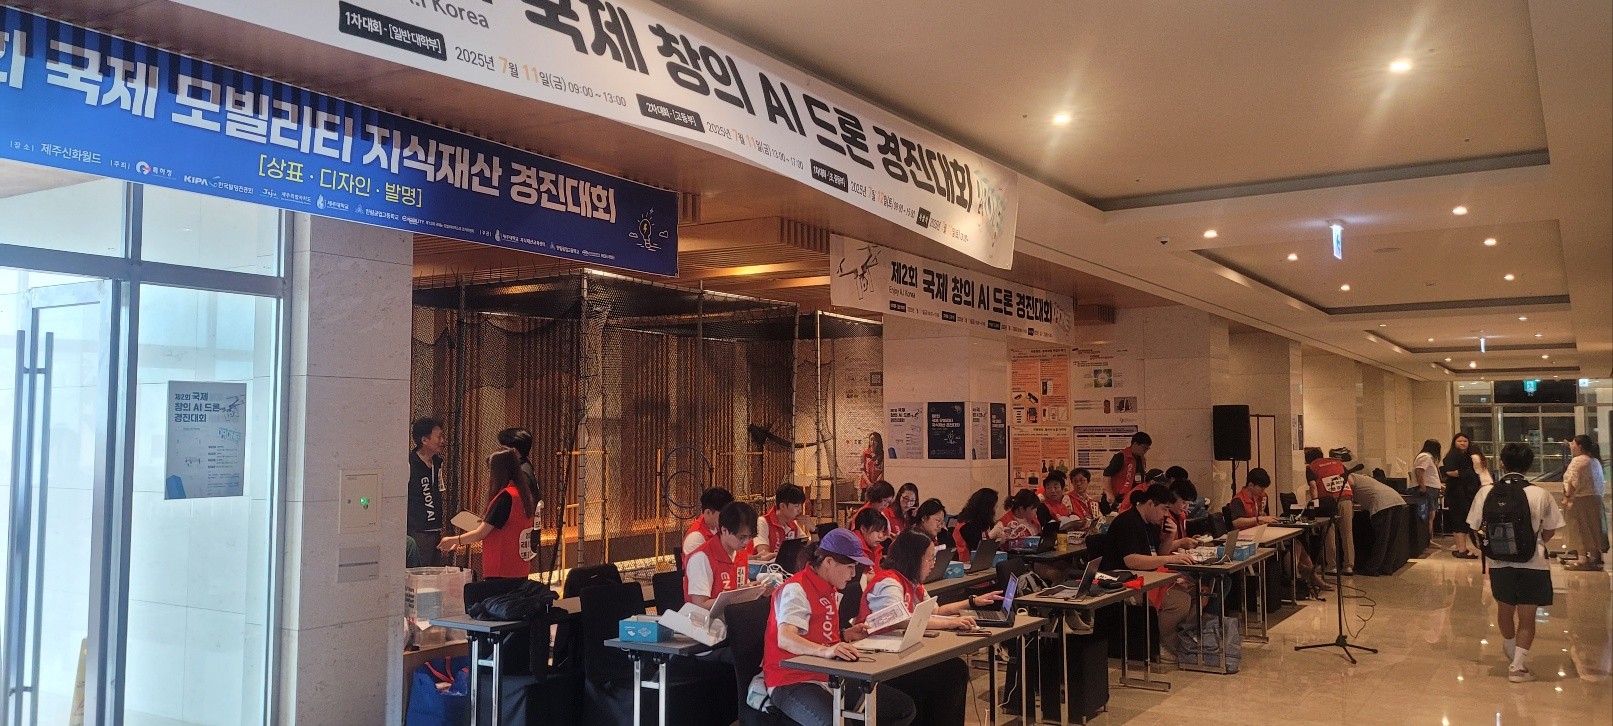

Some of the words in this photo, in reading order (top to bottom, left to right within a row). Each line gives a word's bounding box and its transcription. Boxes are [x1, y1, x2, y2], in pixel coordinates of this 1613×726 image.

[434, 0, 490, 28] Korea
[344, 12, 382, 36] 1차대회
[455, 46, 496, 72] 2025년
[499, 56, 520, 78] 7월
[522, 64, 567, 92] 11일(금)
[568, 81, 594, 98] 09:00
[603, 91, 627, 107] 13:00
[46, 40, 159, 118] 국제
[172, 74, 353, 164] 모빌리티
[362, 124, 502, 196] 지식재산
[510, 160, 617, 224] 경진대회
[648, 23, 756, 116] 창의
[758, 71, 807, 138] AI
[802, 93, 874, 170] 드론
[874, 124, 973, 214] 경진대회
[41, 143, 102, 164] 제주신화월드
[184, 175, 208, 186] KIPA
[320, 168, 371, 197] 디자인
[891, 260, 918, 288] 제2회
[922, 268, 948, 302] 국제
[951, 276, 975, 308] 창의
[978, 284, 989, 311] AI
[992, 287, 1013, 316] 드론
[1016, 292, 1052, 324] 경진대회
[174, 403, 190, 411] 창의
[193, 403, 202, 411] AI
[204, 403, 220, 411] 드론
[192, 392, 208, 401] 국제
[174, 414, 206, 422] 경진대회
[420, 476, 434, 509] ENJOY
[427, 510, 436, 522] AI
[819, 597, 835, 641] ENJOY
